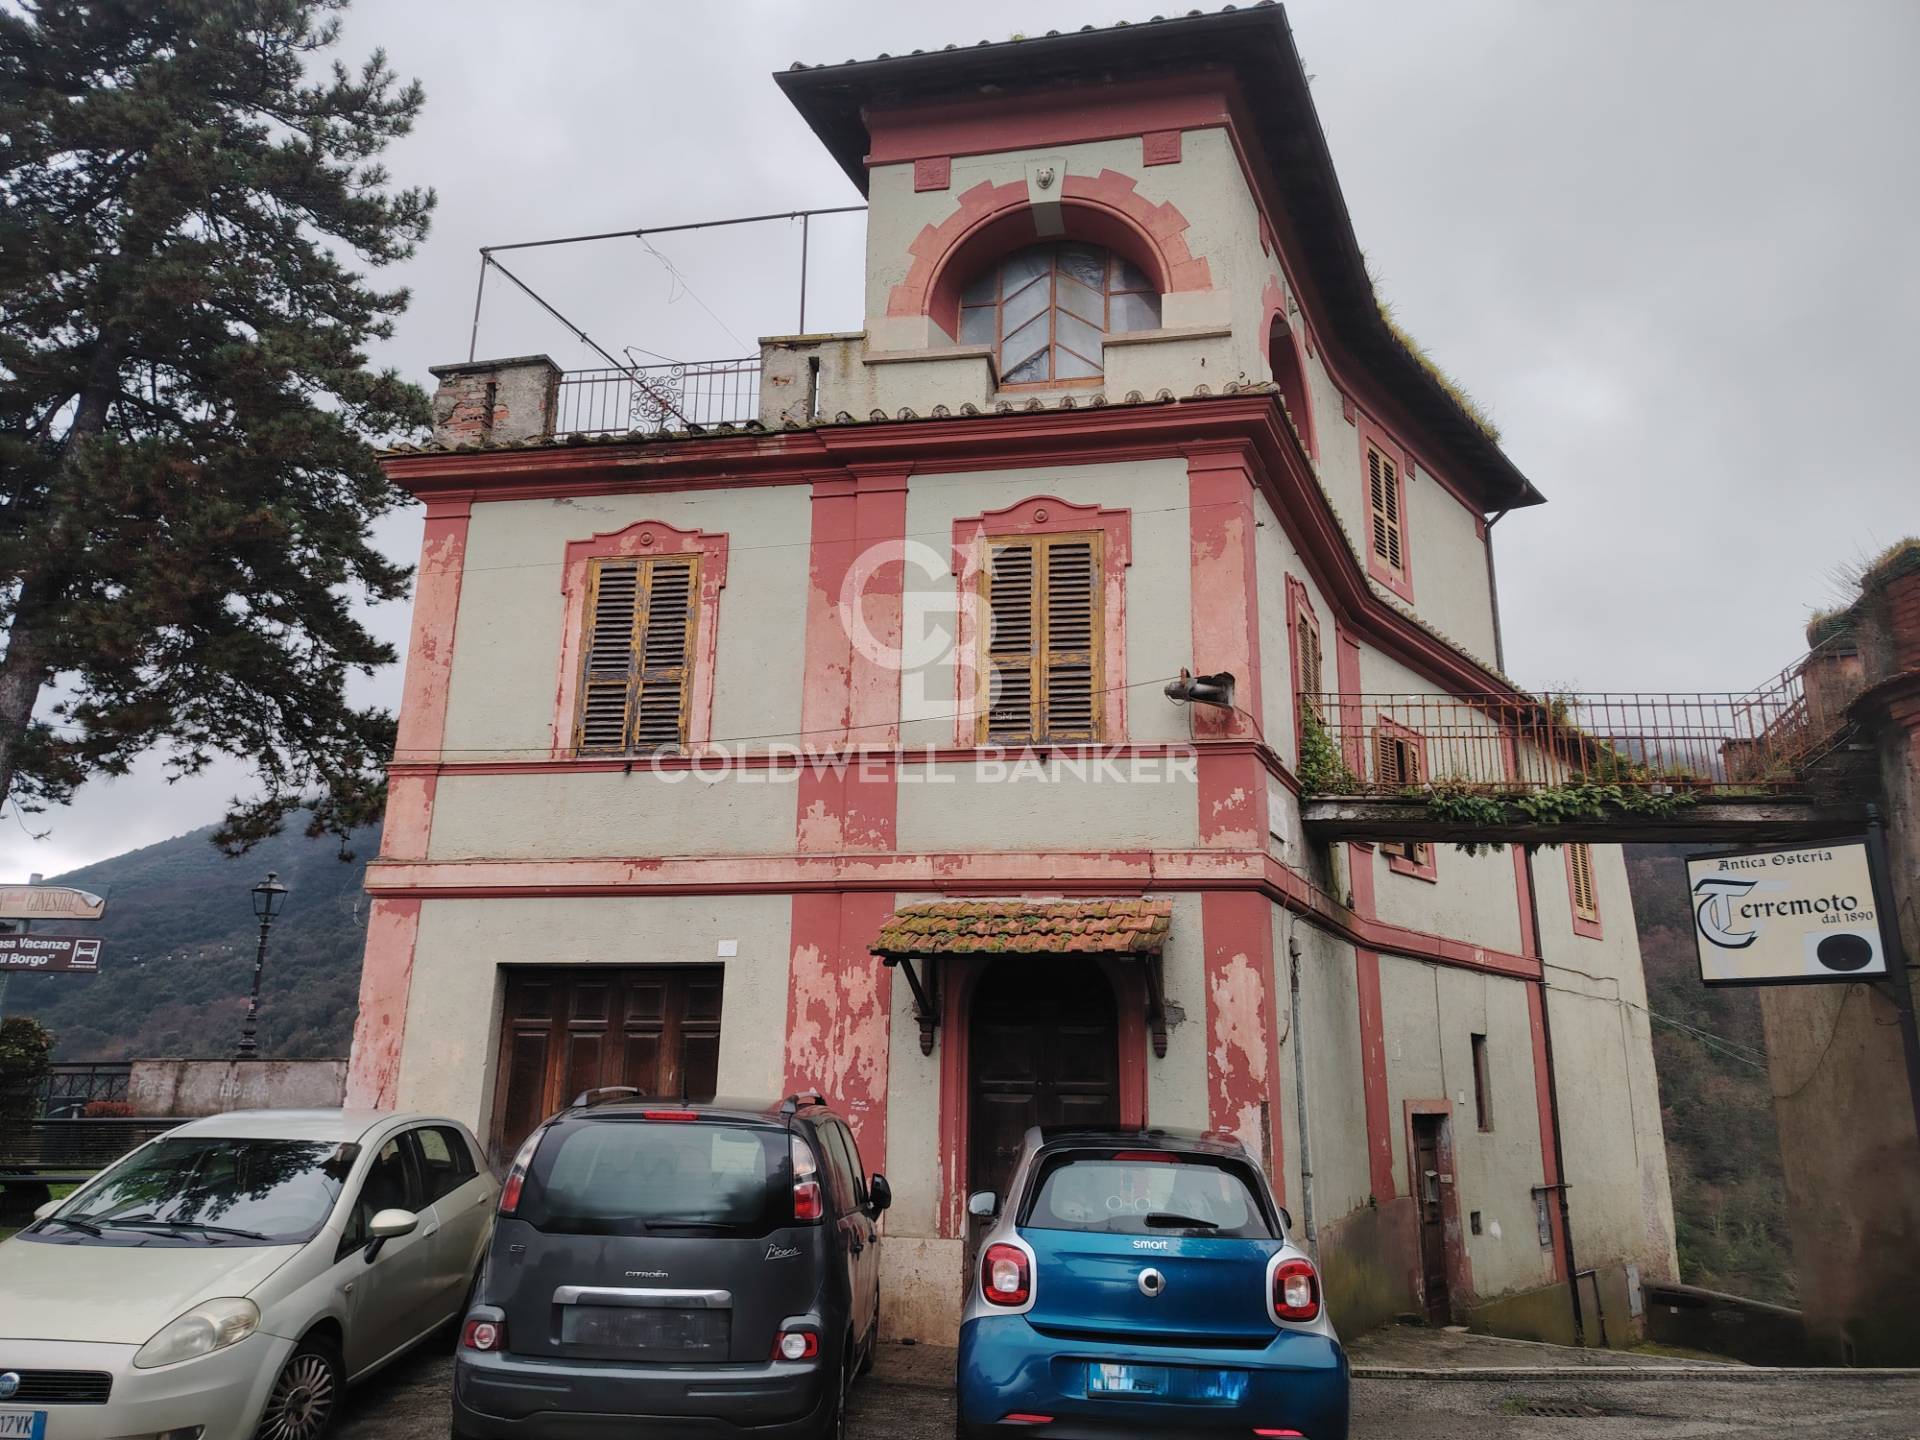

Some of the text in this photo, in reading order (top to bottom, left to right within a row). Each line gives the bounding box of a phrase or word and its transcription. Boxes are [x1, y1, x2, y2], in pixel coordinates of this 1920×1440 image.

[1717, 851, 1833, 871] Antica Osteria
[1692, 878, 1858, 949] Terremoto
[1821, 911, 1874, 924] dal 1890
[19, 938, 71, 950] Vacanze
[1132, 1240, 1168, 1250] smart
